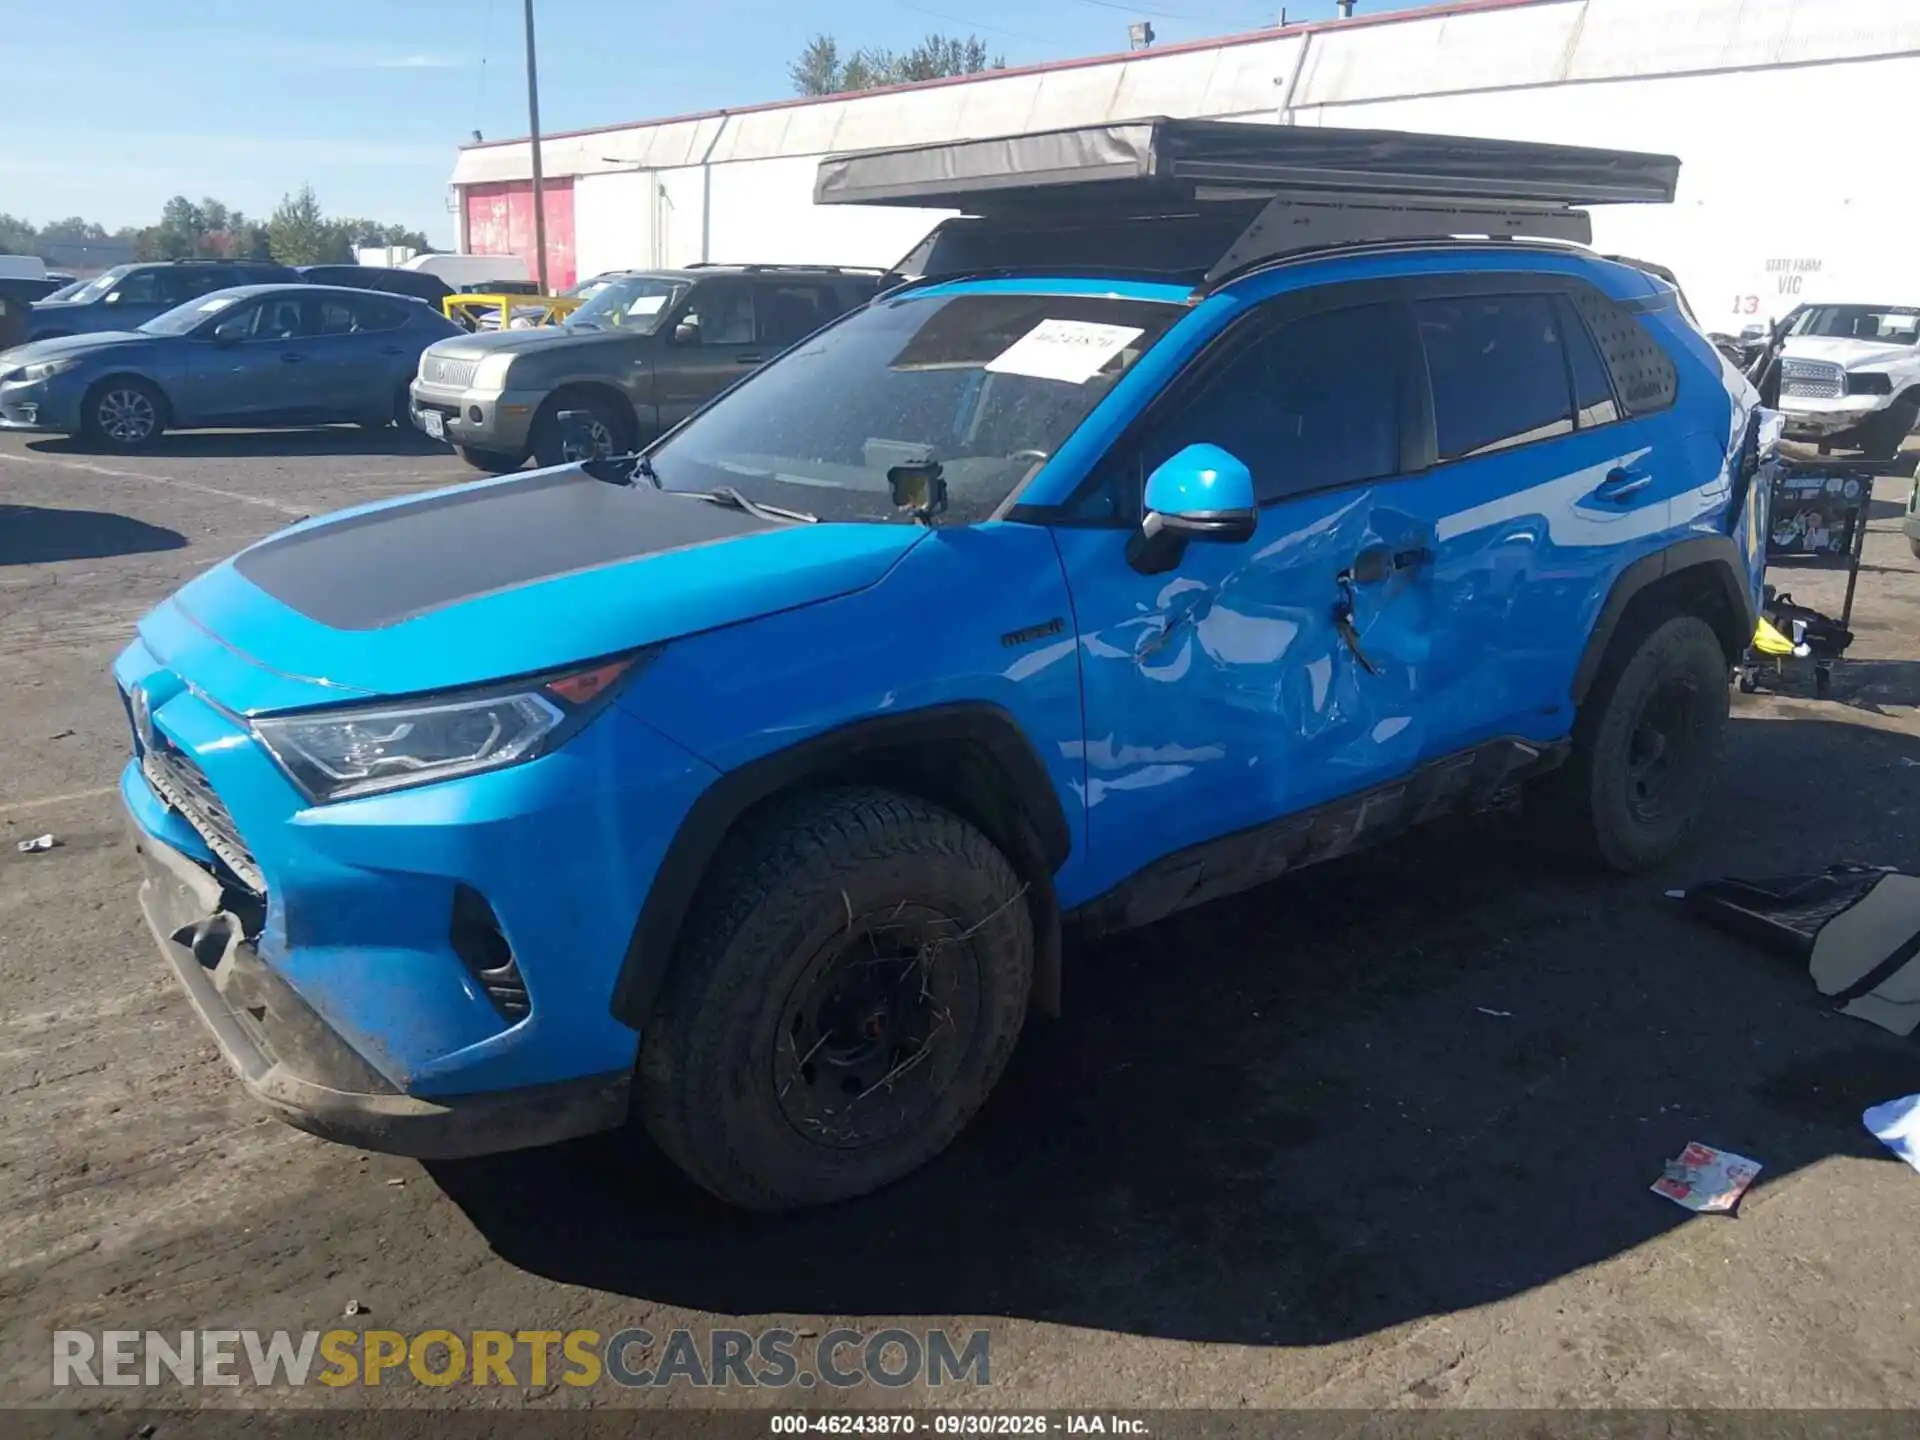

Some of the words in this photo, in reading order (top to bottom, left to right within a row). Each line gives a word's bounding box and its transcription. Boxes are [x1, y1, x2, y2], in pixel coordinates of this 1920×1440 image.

[1764, 259, 1792, 272] STATE
[1778, 275, 1803, 294] VIC
[1732, 295, 1760, 314] 13
